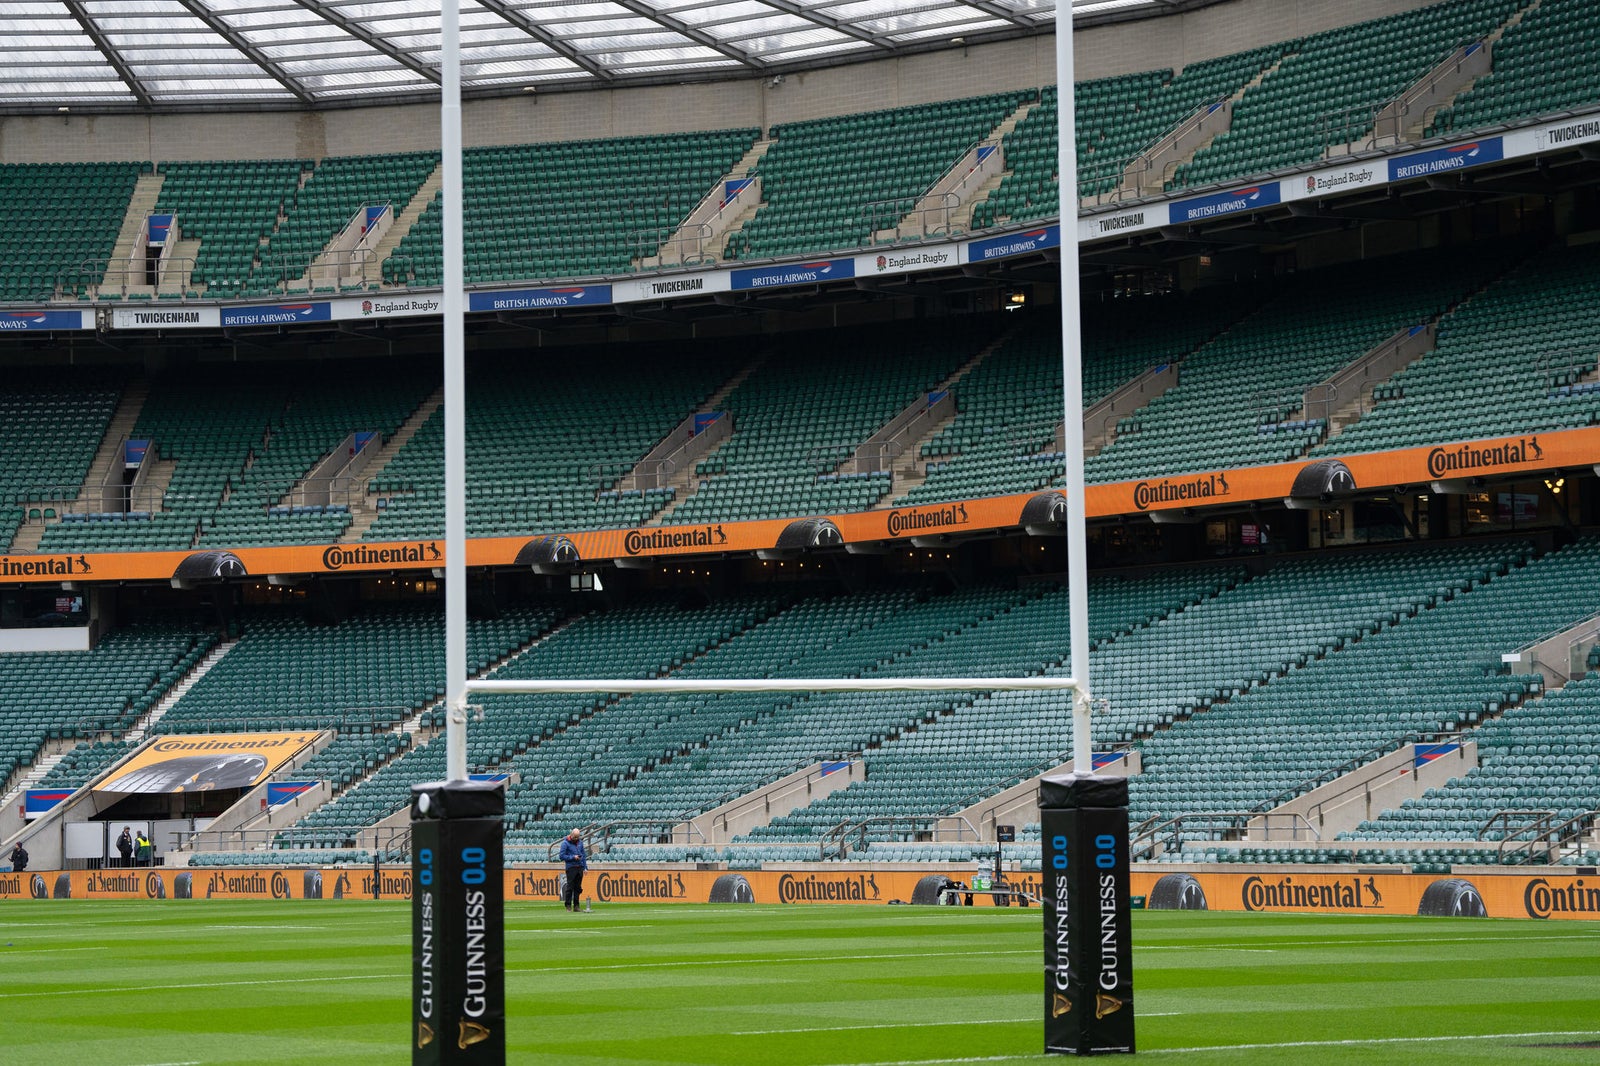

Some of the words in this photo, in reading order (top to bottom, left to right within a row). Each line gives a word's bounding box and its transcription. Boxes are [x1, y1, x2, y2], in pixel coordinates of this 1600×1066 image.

[1317, 173, 1348, 189] England
[1349, 169, 1373, 185] Rugby
[1397, 163, 1429, 178] BRITISH
[1430, 156, 1464, 173] AIRWAYS
[1099, 212, 1144, 233] TWICKENHAM
[1188, 204, 1215, 219] BRITISH
[1216, 199, 1246, 215] AIRWAYS
[889, 255, 921, 268] England
[922, 252, 948, 265] Rugby
[985, 245, 1008, 258] BRITISH
[1008, 240, 1036, 254] AIRWAYS
[652, 278, 703, 295] TWICKENHAM
[752, 275, 783, 287] BRITISH
[784, 271, 817, 284] AIRWAYS
[374, 302, 410, 313] England
[412, 300, 439, 311] Rugby
[494, 299, 529, 309] BRITISH
[531, 296, 568, 306] AIRWAYS
[134, 312, 200, 324] TWICKENHAM
[225, 315, 259, 325] BRITISH
[260, 312, 296, 323] AIRWAYS
[1427, 439, 1527, 478] Continental
[1133, 475, 1216, 510] Continental
[887, 505, 957, 536] Continental
[624, 527, 713, 555] Continental
[0, 556, 73, 576] inental
[322, 543, 425, 570] Continental
[153, 737, 291, 752] Continental
[1052, 835, 1068, 869] 0.0
[1095, 834, 1116, 869] 0.0
[419, 848, 433, 885] 0.0
[461, 847, 487, 885] 0.0
[597, 871, 673, 902] Continental
[778, 873, 867, 904] Continental
[1242, 876, 1363, 911] Continental
[1055, 875, 1069, 991] GUINNESS
[1100, 874, 1118, 991] GUINNESS
[420, 891, 433, 1018] GUINNESS
[463, 890, 487, 1018] GUINNESS
